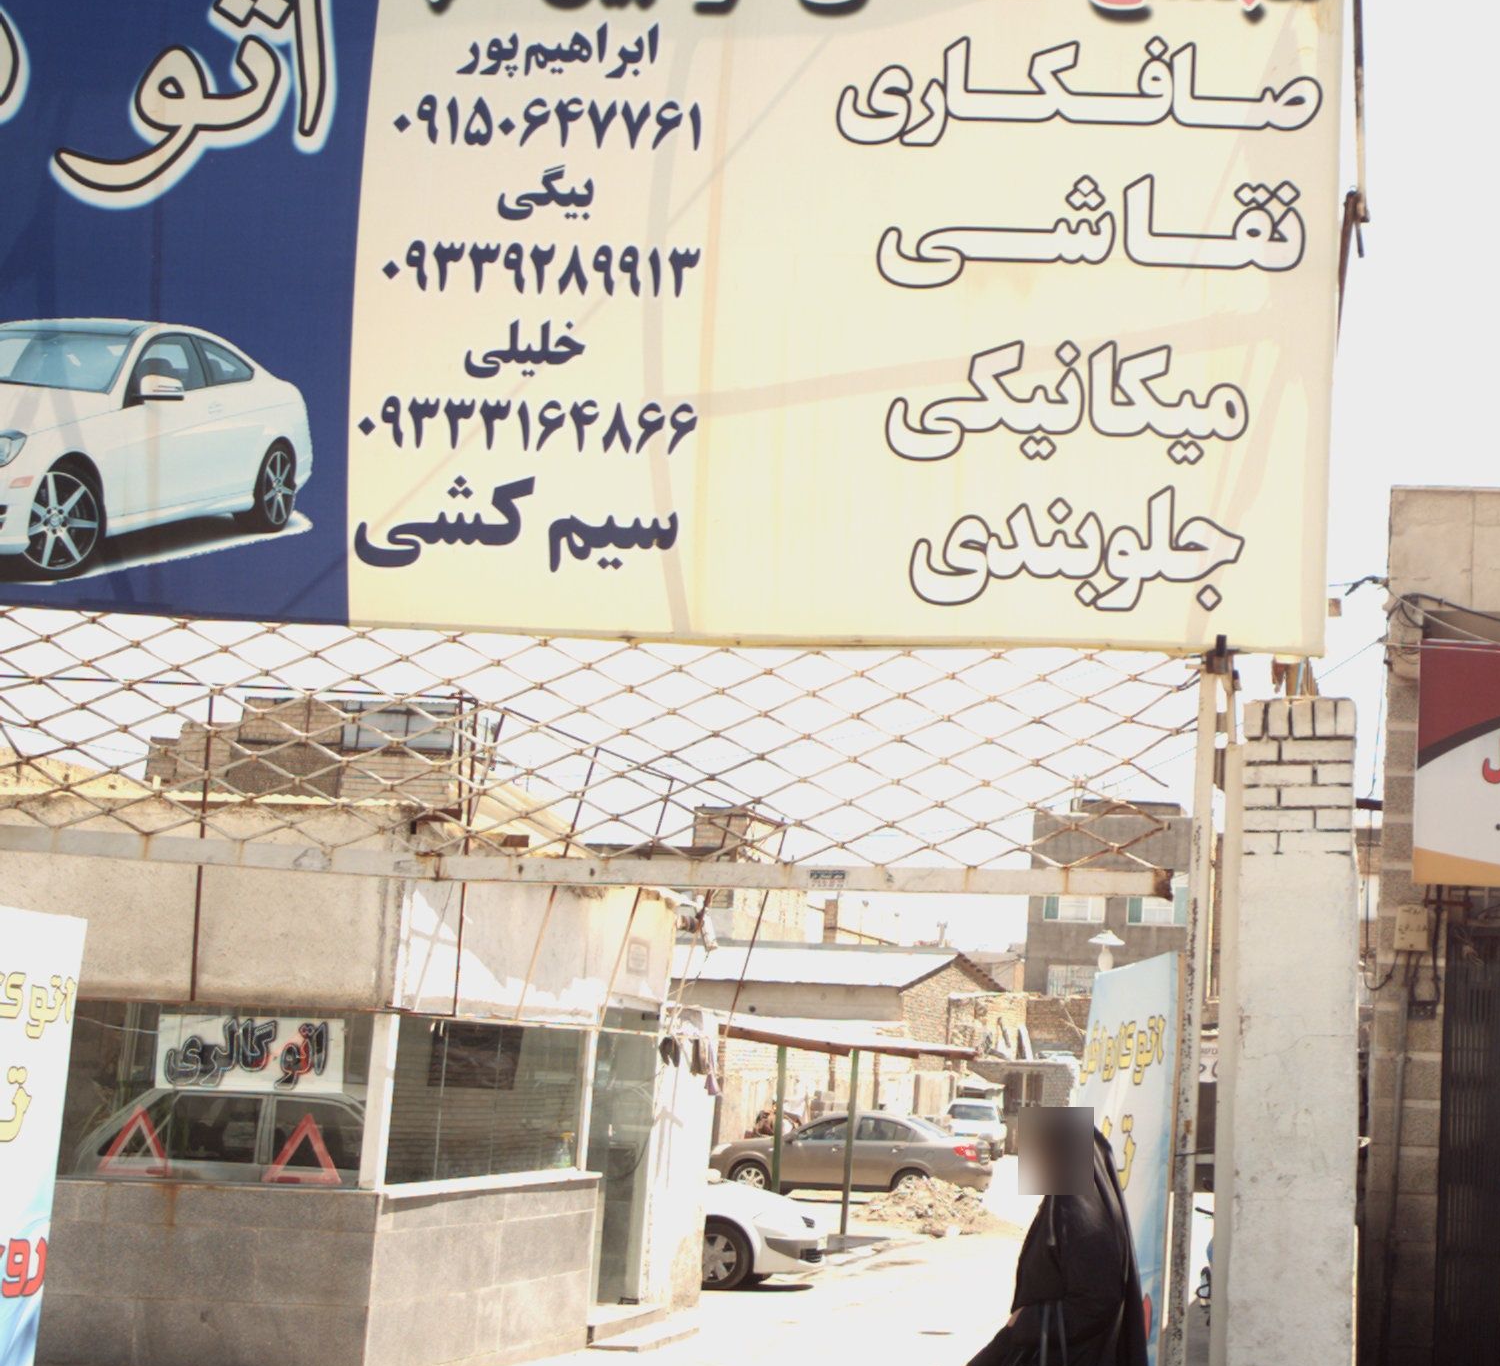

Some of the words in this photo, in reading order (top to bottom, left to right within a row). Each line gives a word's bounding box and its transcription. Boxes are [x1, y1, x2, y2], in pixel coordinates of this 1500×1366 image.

[392, 93, 702, 152] ۰۹۱۵۰۶۴۷۷۶۱
[836, 35, 1323, 147] صافکاری
[496, 164, 595, 221] بیگی
[876, 173, 1306, 289] نقاشی
[381, 239, 702, 299] ۰۹۳۳۹۲۸۹۹۱۳
[463, 318, 587, 379] خلیلی
[357, 395, 699, 456] ۰۹۳۳۳۱۶۴۸۶۶
[885, 339, 1250, 466] میکانیکی
[353, 474, 536, 569] کشی
[548, 511, 679, 573] سیم
[909, 485, 1246, 613] جلوبندی
[164, 1018, 278, 1087] گالری
[274, 1021, 329, 1090] اتو
